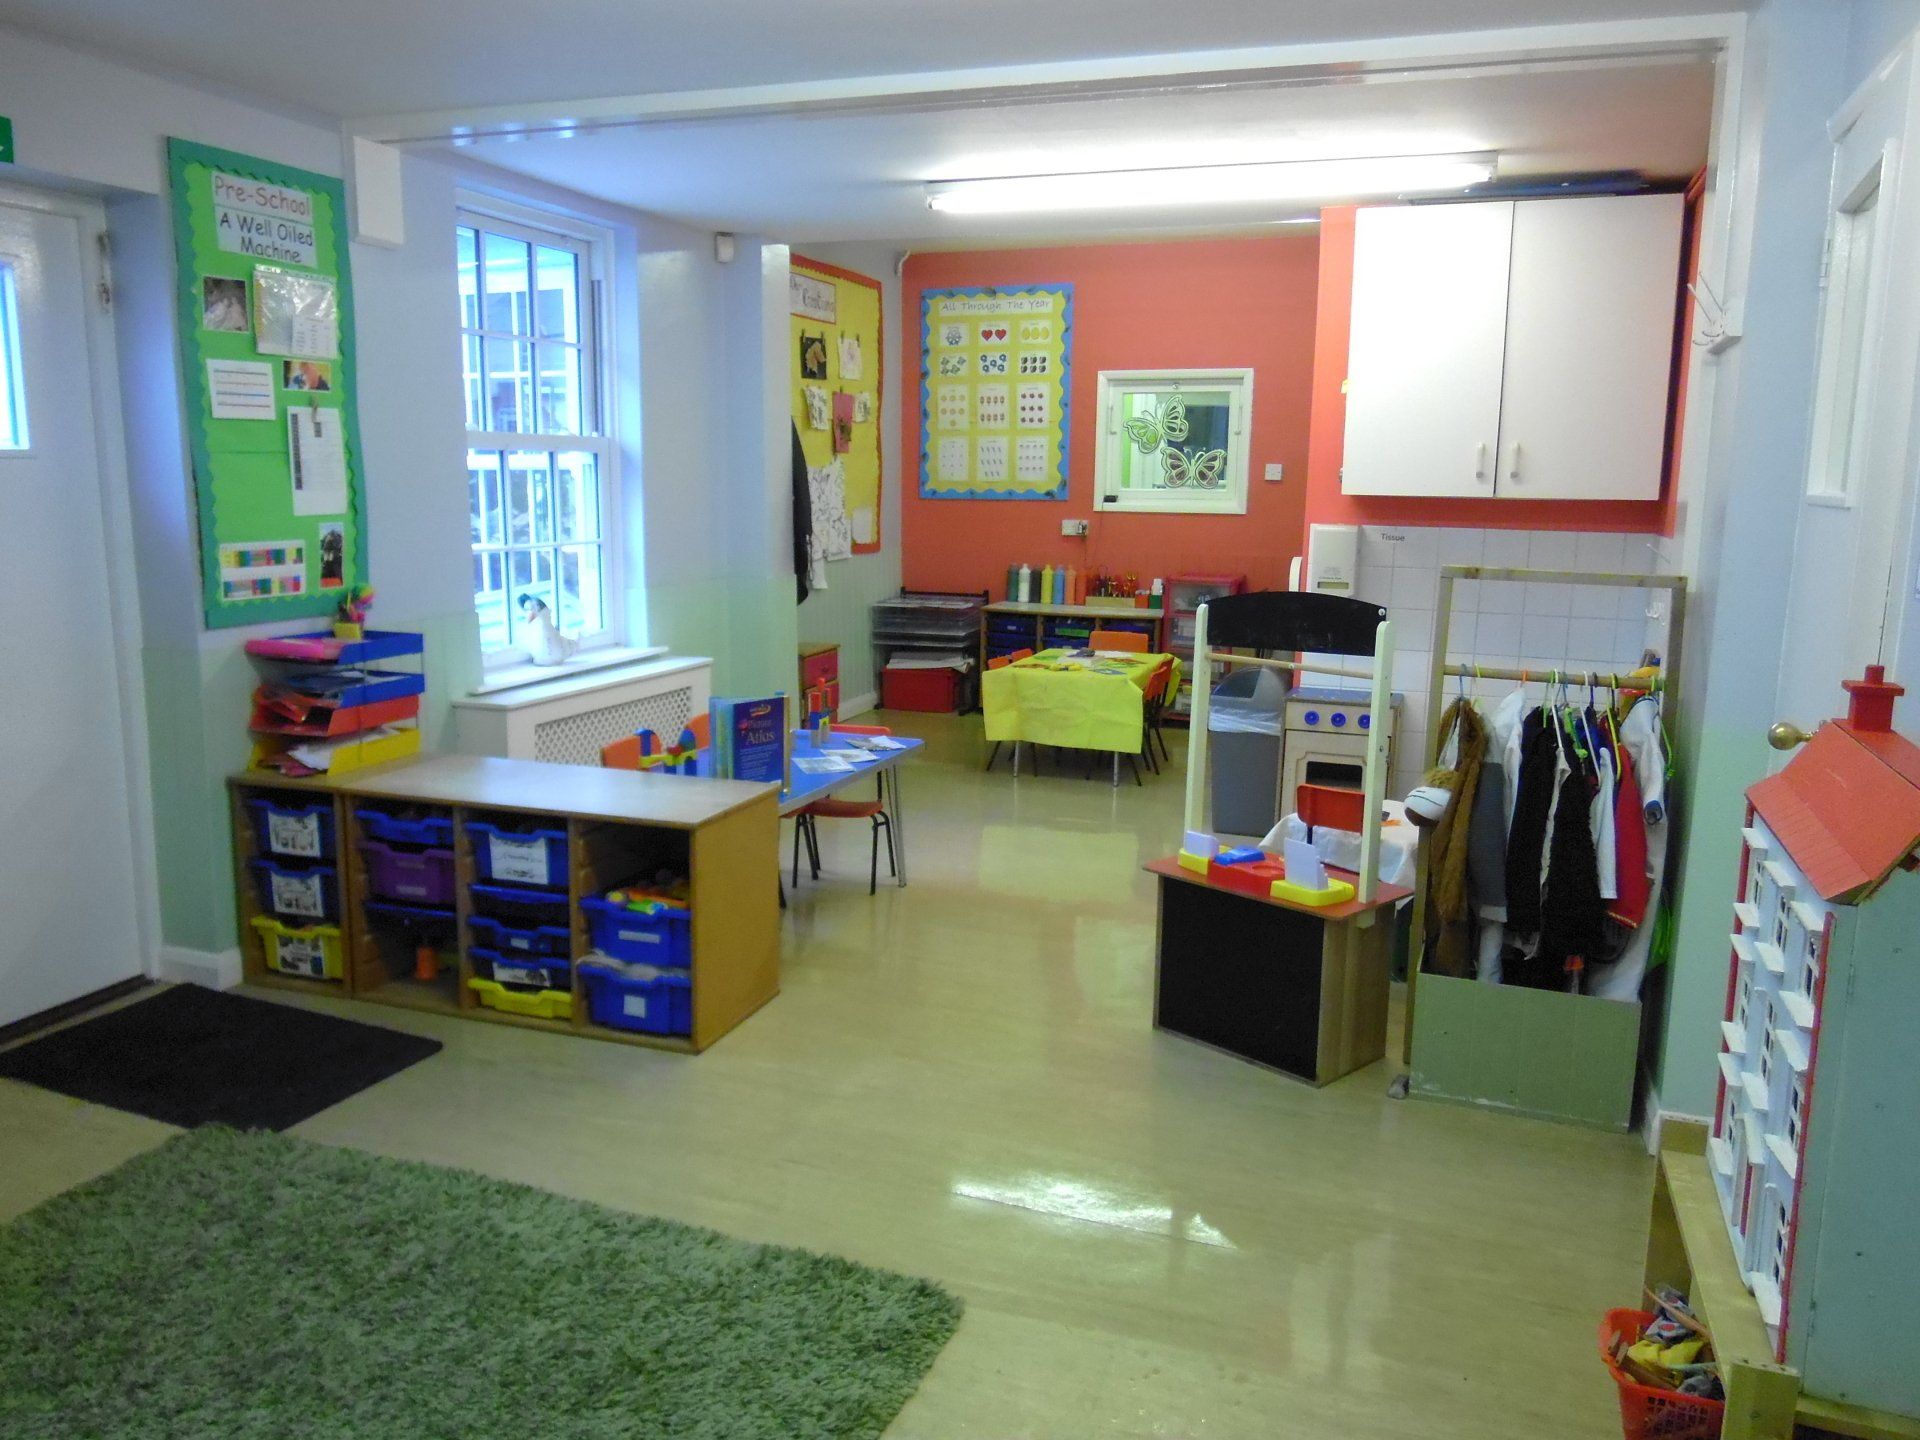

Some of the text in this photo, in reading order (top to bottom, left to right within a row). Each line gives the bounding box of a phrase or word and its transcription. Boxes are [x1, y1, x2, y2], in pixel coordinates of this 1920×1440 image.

[215, 175, 310, 217] Pre-School
[220, 212, 313, 247] A Well Oiled
[240, 236, 302, 263] Machine
[942, 298, 1050, 314] All Through The Year
[1381, 533, 1406, 542] Tissue
